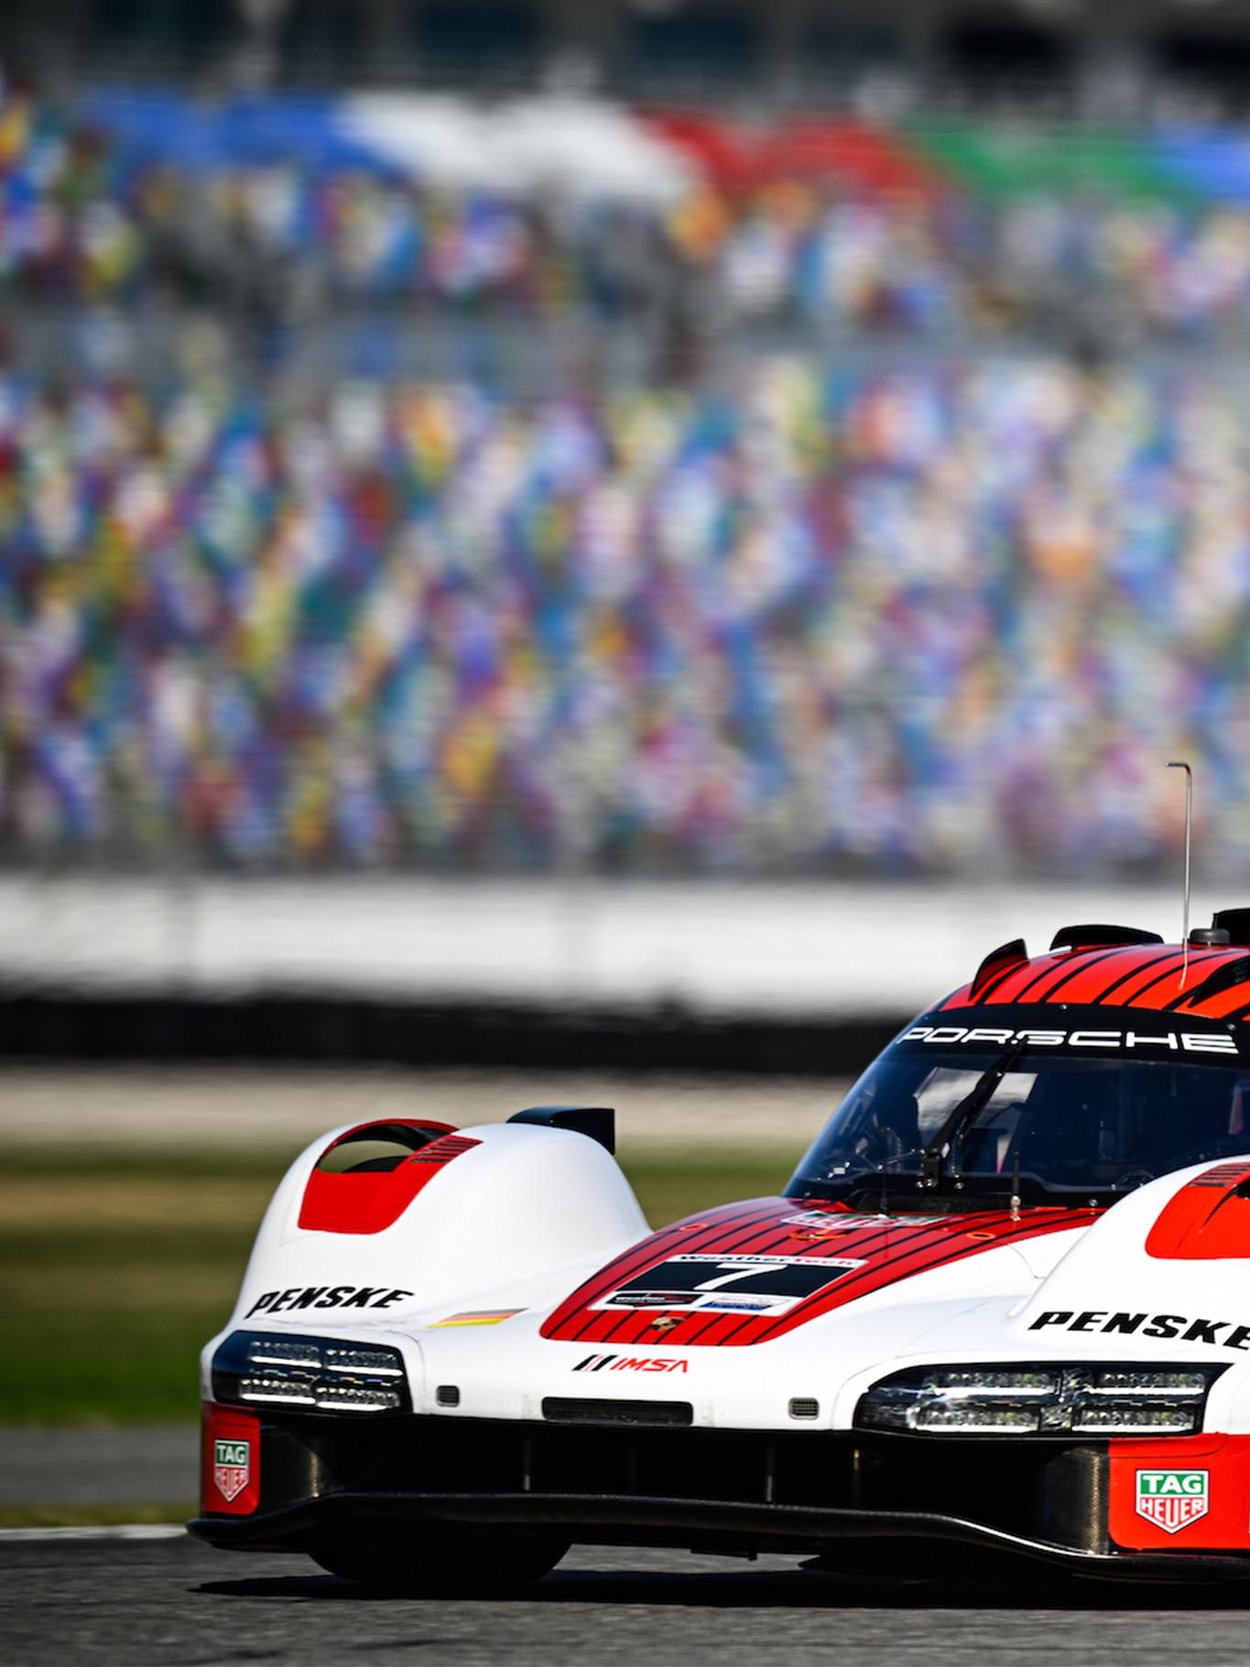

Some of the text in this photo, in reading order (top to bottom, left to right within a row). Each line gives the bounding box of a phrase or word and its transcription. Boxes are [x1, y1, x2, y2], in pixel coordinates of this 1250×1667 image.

[896, 1026, 1239, 1055] PORSCHE
[680, 1254, 857, 1267] WeatherTech
[693, 1262, 788, 1291] 7
[243, 1286, 415, 1320] PENSKE
[609, 1357, 689, 1374] IMSA
[216, 1445, 246, 1465] TAG
[1142, 1472, 1204, 1494] TAG
[1140, 1497, 1205, 1528] HEUER
